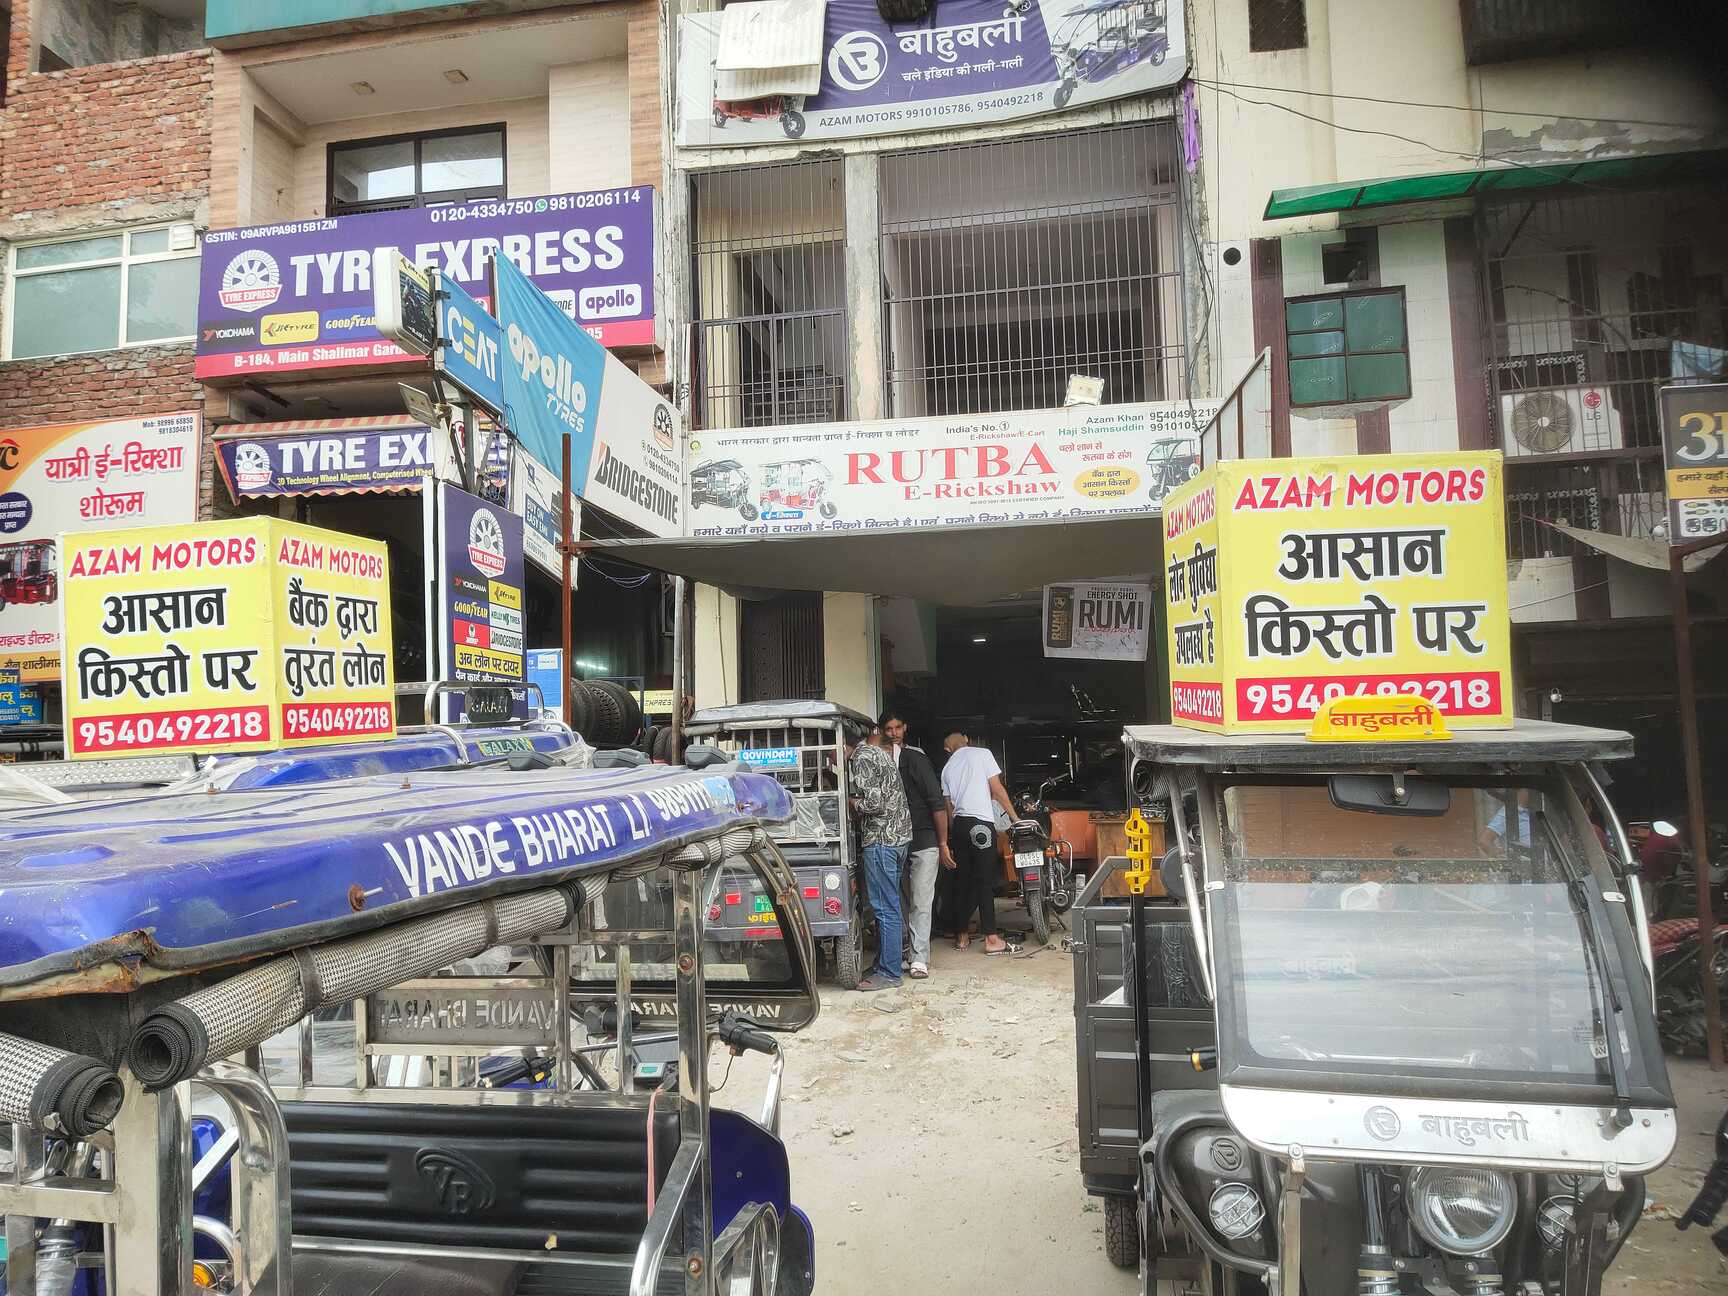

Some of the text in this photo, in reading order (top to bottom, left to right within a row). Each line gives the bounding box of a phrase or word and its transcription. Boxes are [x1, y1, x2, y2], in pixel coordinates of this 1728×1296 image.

[895, 12, 1025, 61] बाहुबली
[901, 68, 921, 82] चले
[924, 65, 953, 81] इंडिया
[957, 61, 971, 75] की
[818, 91, 1044, 127] AZAM MOTORS 9910105786, 9540492218
[430, 190, 640, 223] 0120-4334750 9810206114
[205, 231, 238, 244] GSTIN:
[290, 249, 374, 297] TYR
[416, 225, 625, 283] EXPRESS
[586, 288, 635, 314] apollo
[215, 326, 255, 339] YOKOHAMA
[447, 306, 499, 382] CEAT
[278, 349, 309, 364] Main
[312, 344, 370, 361] Shalimar
[508, 323, 588, 414] apollo
[546, 392, 585, 434] TYRES
[946, 424, 979, 434] India's
[981, 424, 998, 432] No.
[1058, 424, 1145, 437] Haji Shamsuddin
[1086, 416, 1115, 425] Azam
[1117, 414, 1144, 423] Khan
[45, 442, 183, 480] यात्री ई-रिक्शा
[278, 437, 366, 474] TYRE
[845, 441, 1057, 487] RUTBA
[320, 473, 339, 483] Wheel
[594, 441, 679, 525] BRIDGESTONE
[904, 477, 1062, 502] E-Rickshaw
[1234, 469, 1486, 511] AZAM MOTORS
[80, 487, 144, 520] शोरूम
[1167, 487, 1215, 540] AZAM MOTORS
[69, 537, 256, 578] AZAM MOTORS
[279, 537, 383, 580] AZAM MOTORS
[1278, 529, 1446, 582] आसान
[1087, 590, 1137, 600] ENERGY SHOT
[1168, 542, 1216, 613] लोन सुविधा
[103, 587, 227, 635] आसान
[288, 577, 378, 640] बैंक द्वारा
[454, 601, 488, 619] GOODYEAR
[1079, 600, 1145, 630] RUMI
[1244, 593, 1486, 659] किस्तो पर
[1204, 607, 1214, 664] है
[78, 643, 258, 700] किस्तो पर
[284, 637, 386, 697] तुरंत लोन
[459, 652, 472, 667] अब
[474, 649, 490, 669] लोन
[492, 657, 502, 671] पर
[503, 659, 519, 674] टायर
[286, 706, 390, 734] 9540492218
[1174, 687, 1222, 718] 9540492218
[1329, 704, 1434, 733] बाहुबली
[79, 711, 262, 748] 9540492218
[483, 737, 529, 755] GALAXY
[383, 820, 516, 898] VANDE
[511, 804, 616, 869] BHARAT
[1418, 1110, 1529, 1146] बाहुबली
